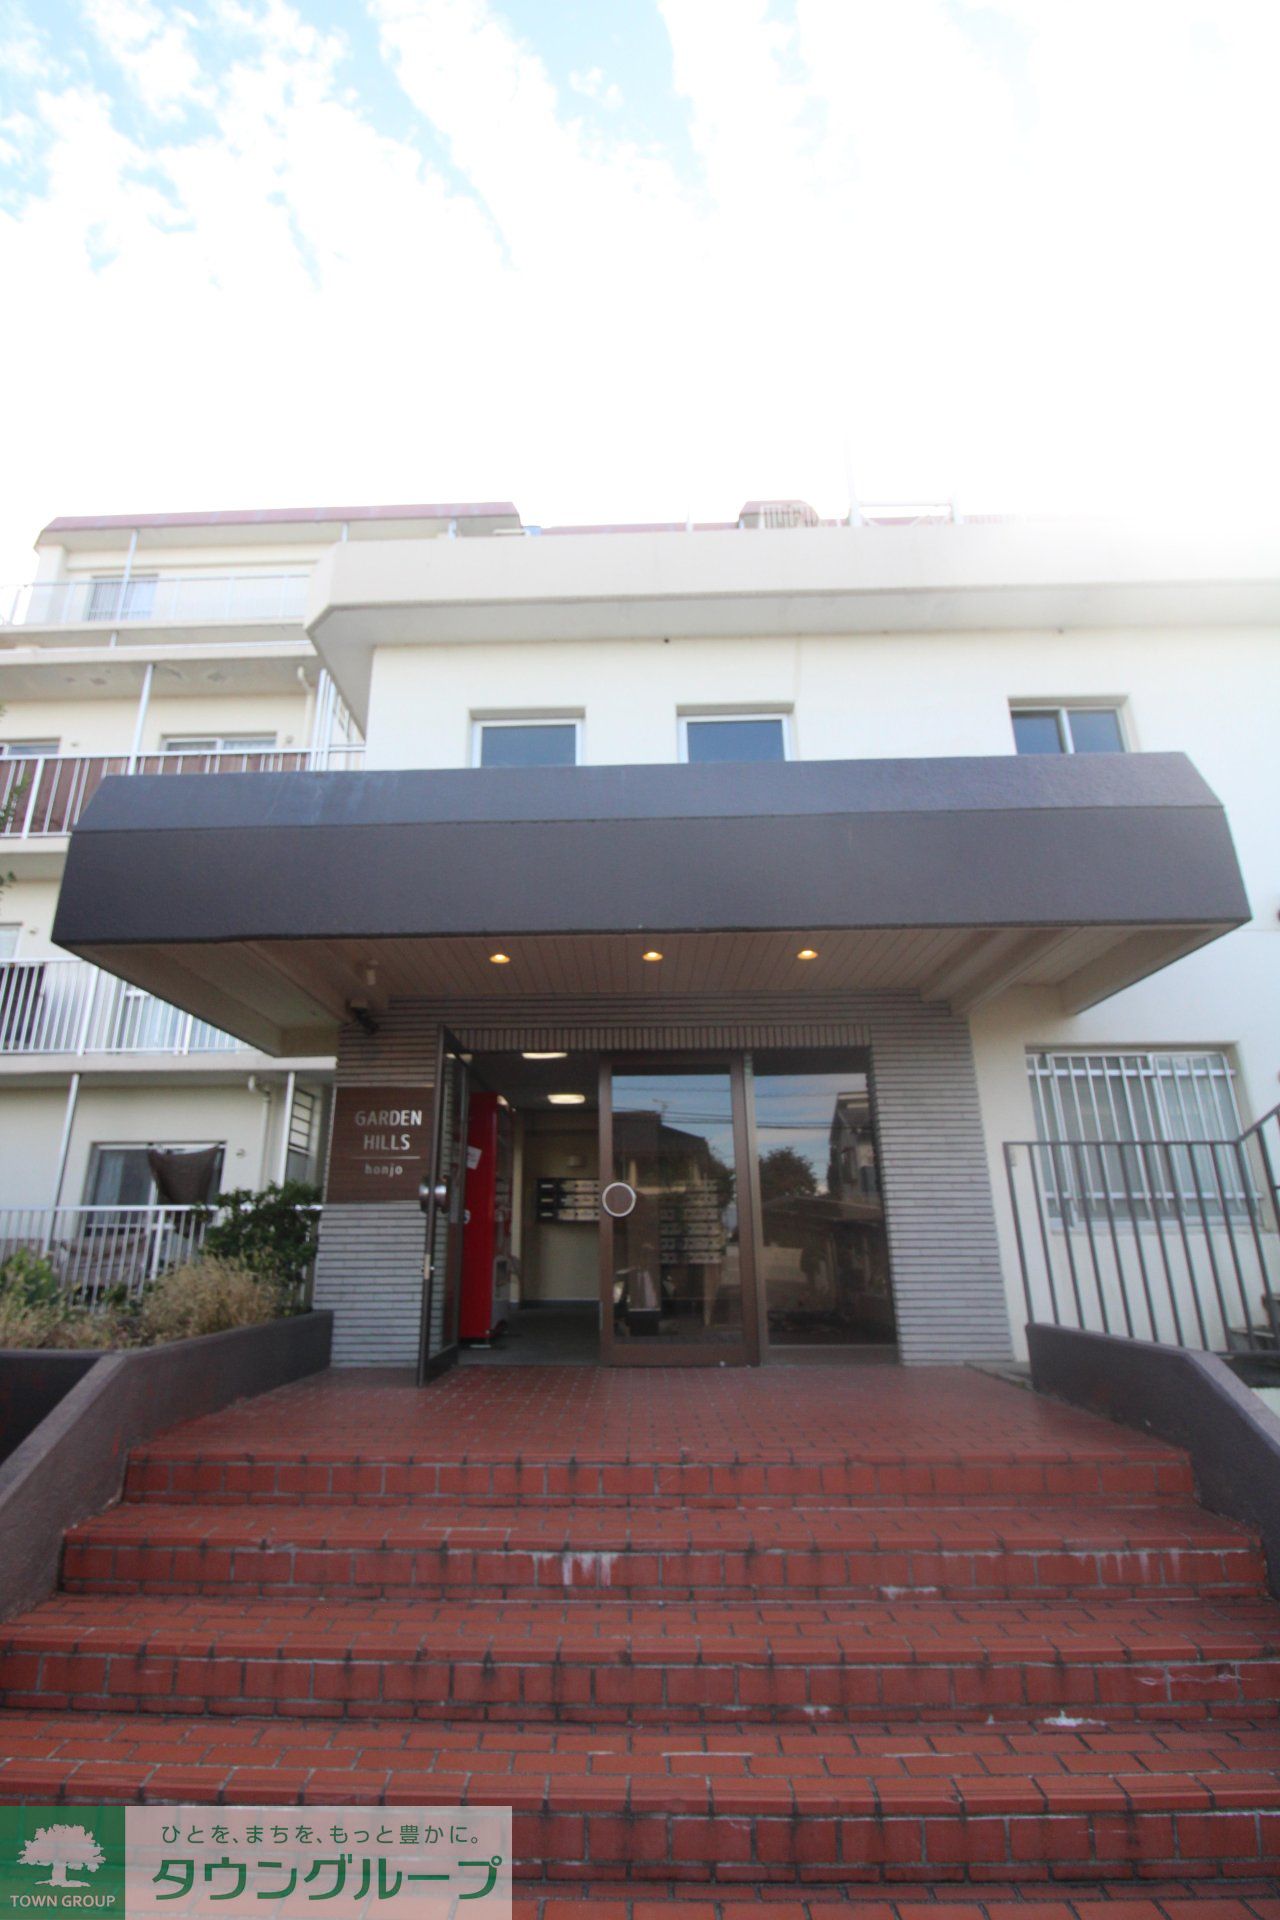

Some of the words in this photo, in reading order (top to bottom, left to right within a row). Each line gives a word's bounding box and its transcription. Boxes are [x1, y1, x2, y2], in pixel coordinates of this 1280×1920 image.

[355, 1109, 422, 1126] GARDEN
[363, 1133, 411, 1151] HILLS
[364, 1163, 403, 1178] honjo
